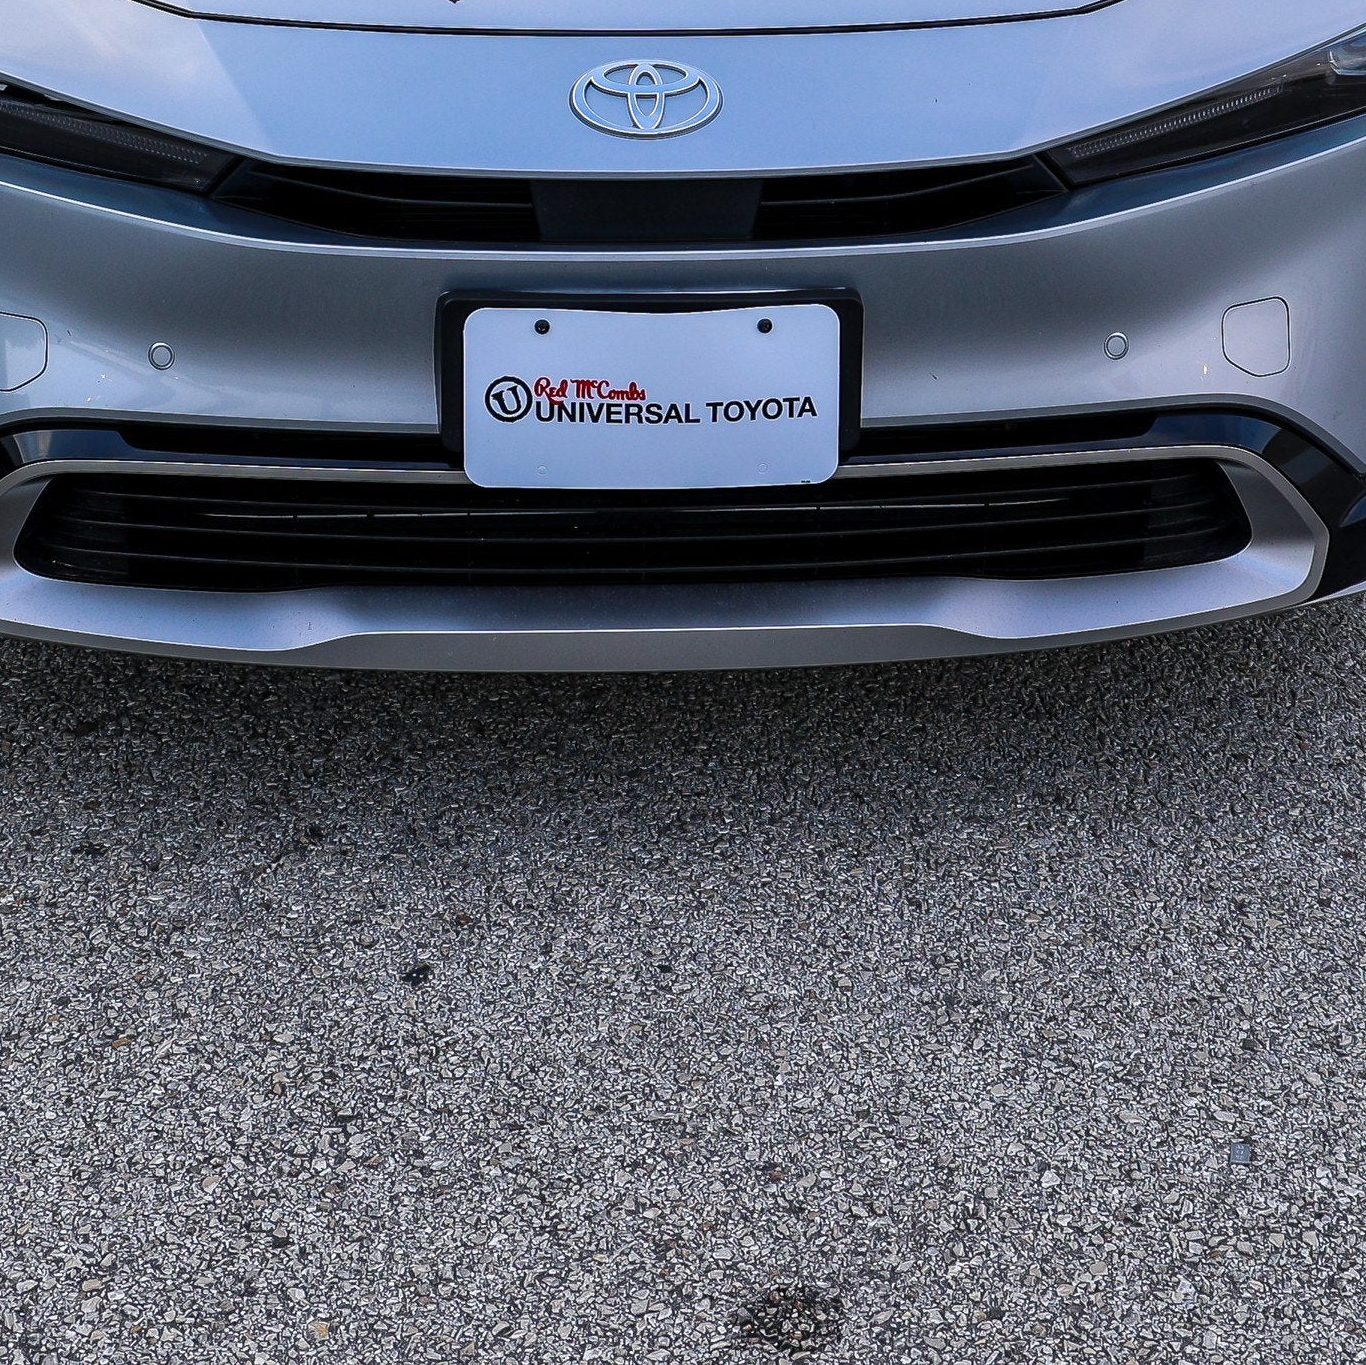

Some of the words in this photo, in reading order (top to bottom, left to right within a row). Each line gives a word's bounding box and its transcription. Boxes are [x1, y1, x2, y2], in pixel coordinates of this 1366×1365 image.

[490, 385, 522, 415] U
[534, 376, 568, 406] Red
[570, 378, 646, 401] McCombs
[535, 400, 701, 425] UNIVERSAL
[706, 396, 818, 423] TOYOTA
